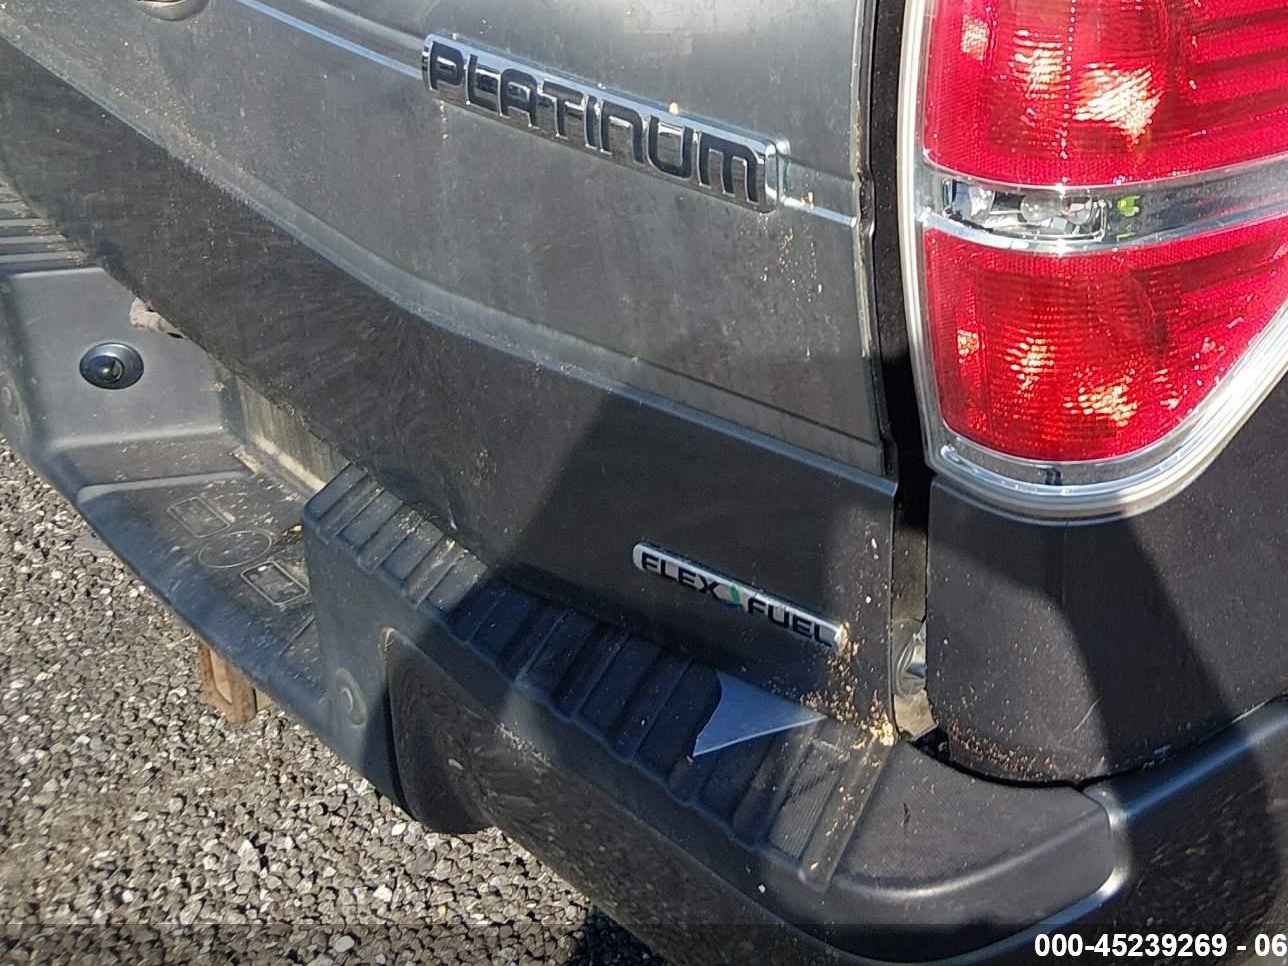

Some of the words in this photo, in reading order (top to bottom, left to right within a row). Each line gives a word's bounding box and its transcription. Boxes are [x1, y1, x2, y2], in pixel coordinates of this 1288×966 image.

[429, 40, 762, 203] PLATINUM
[642, 551, 730, 602] FLEX
[747, 597, 833, 648] FUEL
